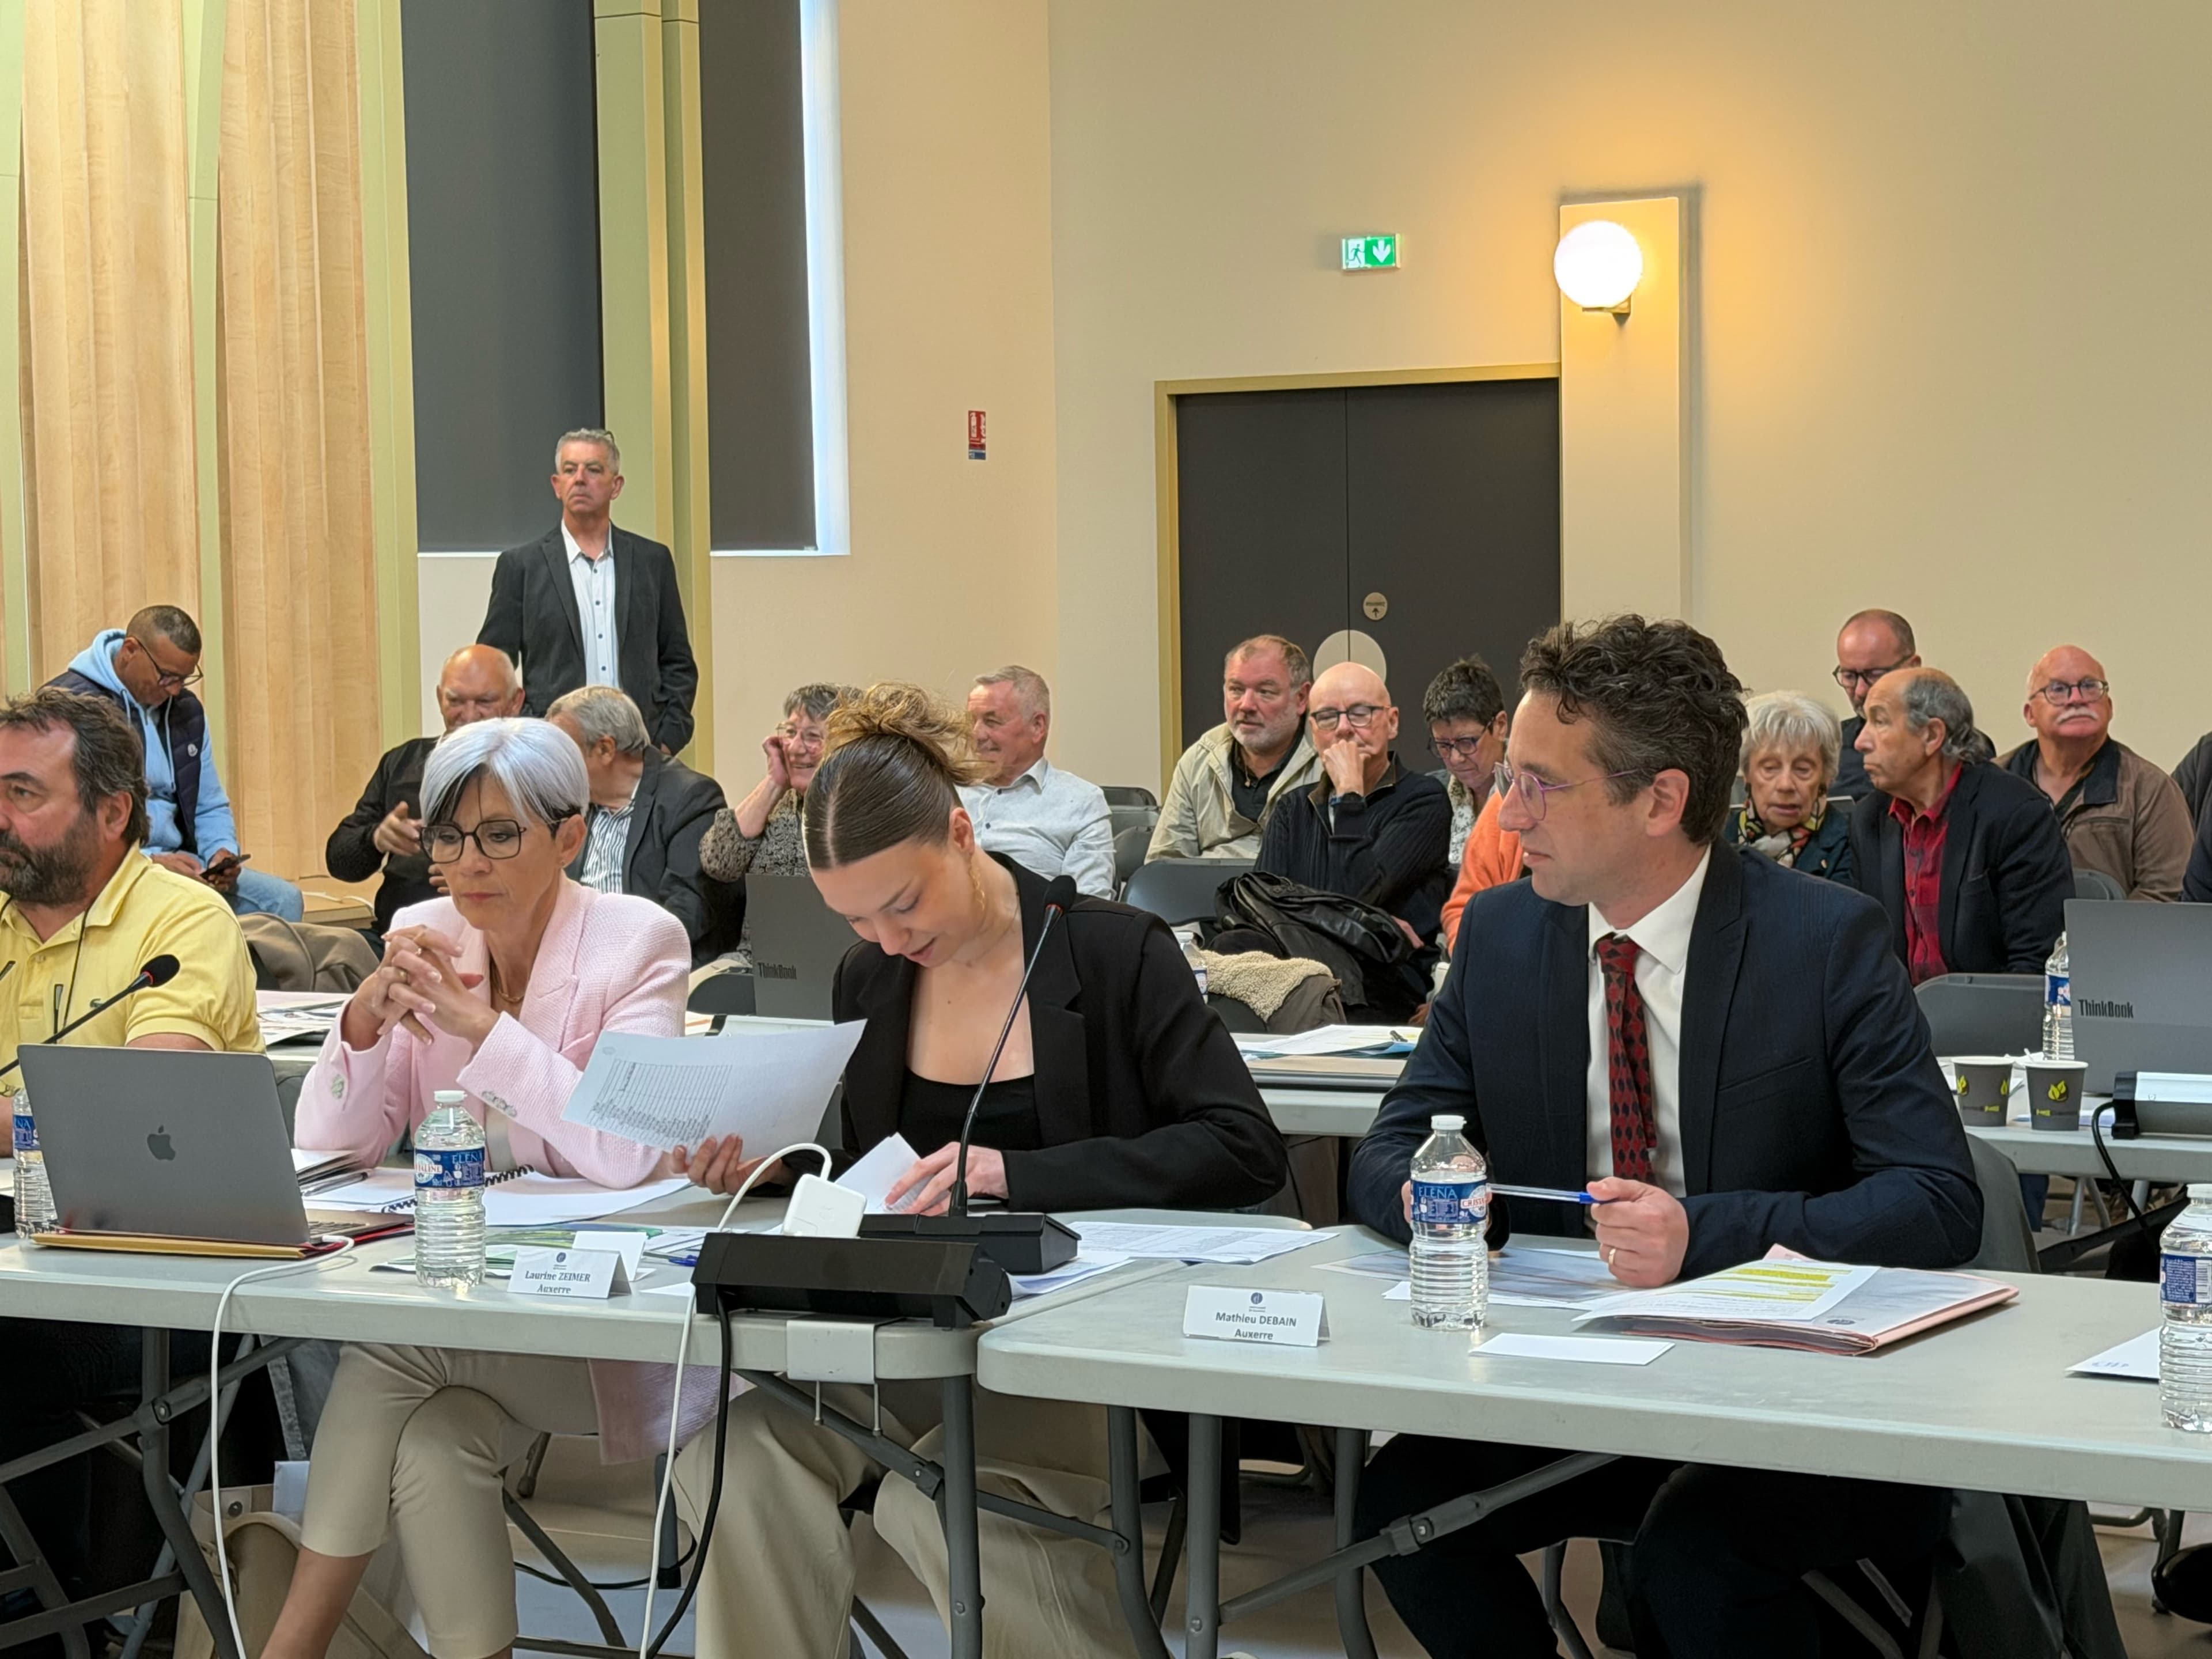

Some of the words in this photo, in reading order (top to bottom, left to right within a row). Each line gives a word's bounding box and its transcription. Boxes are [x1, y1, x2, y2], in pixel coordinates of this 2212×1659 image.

[757, 962, 797, 979] ThinkBook
[2078, 999, 2134, 1018] ThinkBook
[1418, 1186, 1457, 1199] ELENA
[525, 1270, 556, 1281] Laurine
[558, 1272, 591, 1283] ZEIMER
[536, 1283, 571, 1294] Auxerre
[1215, 1312, 1256, 1324] Mathieu
[1259, 1315, 1297, 1327] DEBAIN
[1234, 1328, 1274, 1340] Auxerre
